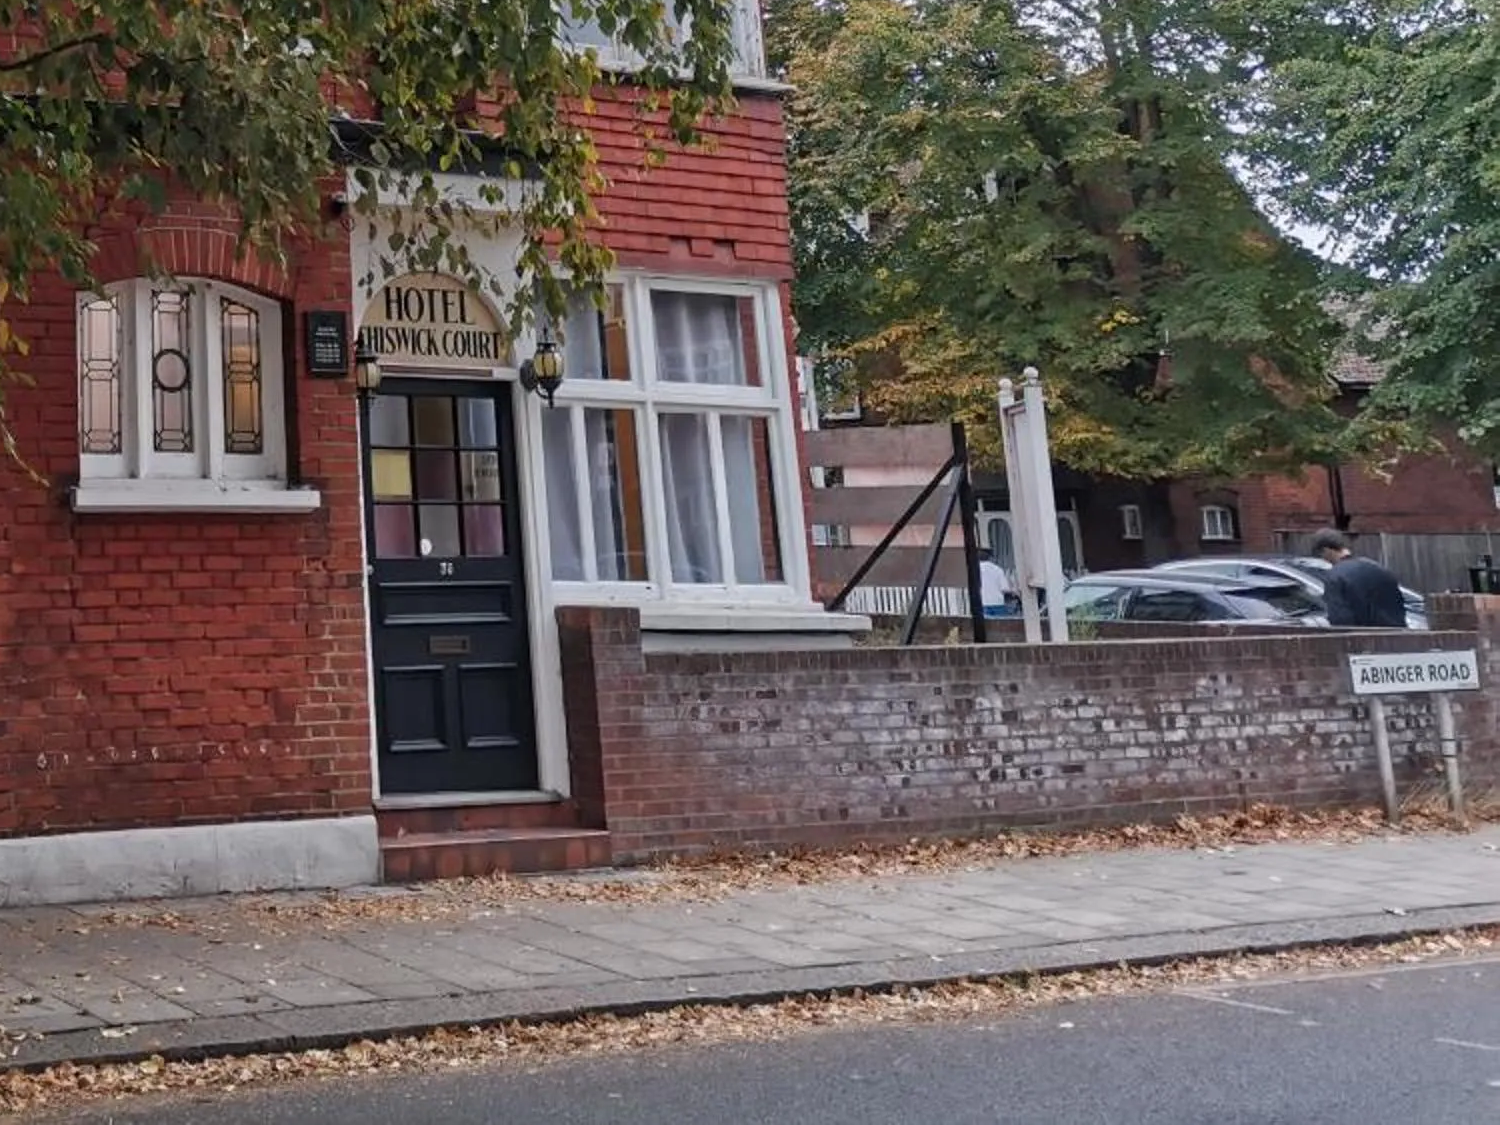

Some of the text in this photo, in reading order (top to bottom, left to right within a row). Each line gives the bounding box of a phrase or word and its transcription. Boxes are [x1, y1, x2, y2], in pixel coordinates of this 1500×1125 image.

[384, 285, 476, 326] HOTEL
[442, 329, 501, 360] COURT
[1361, 663, 1470, 684] ABINGER ROAD
